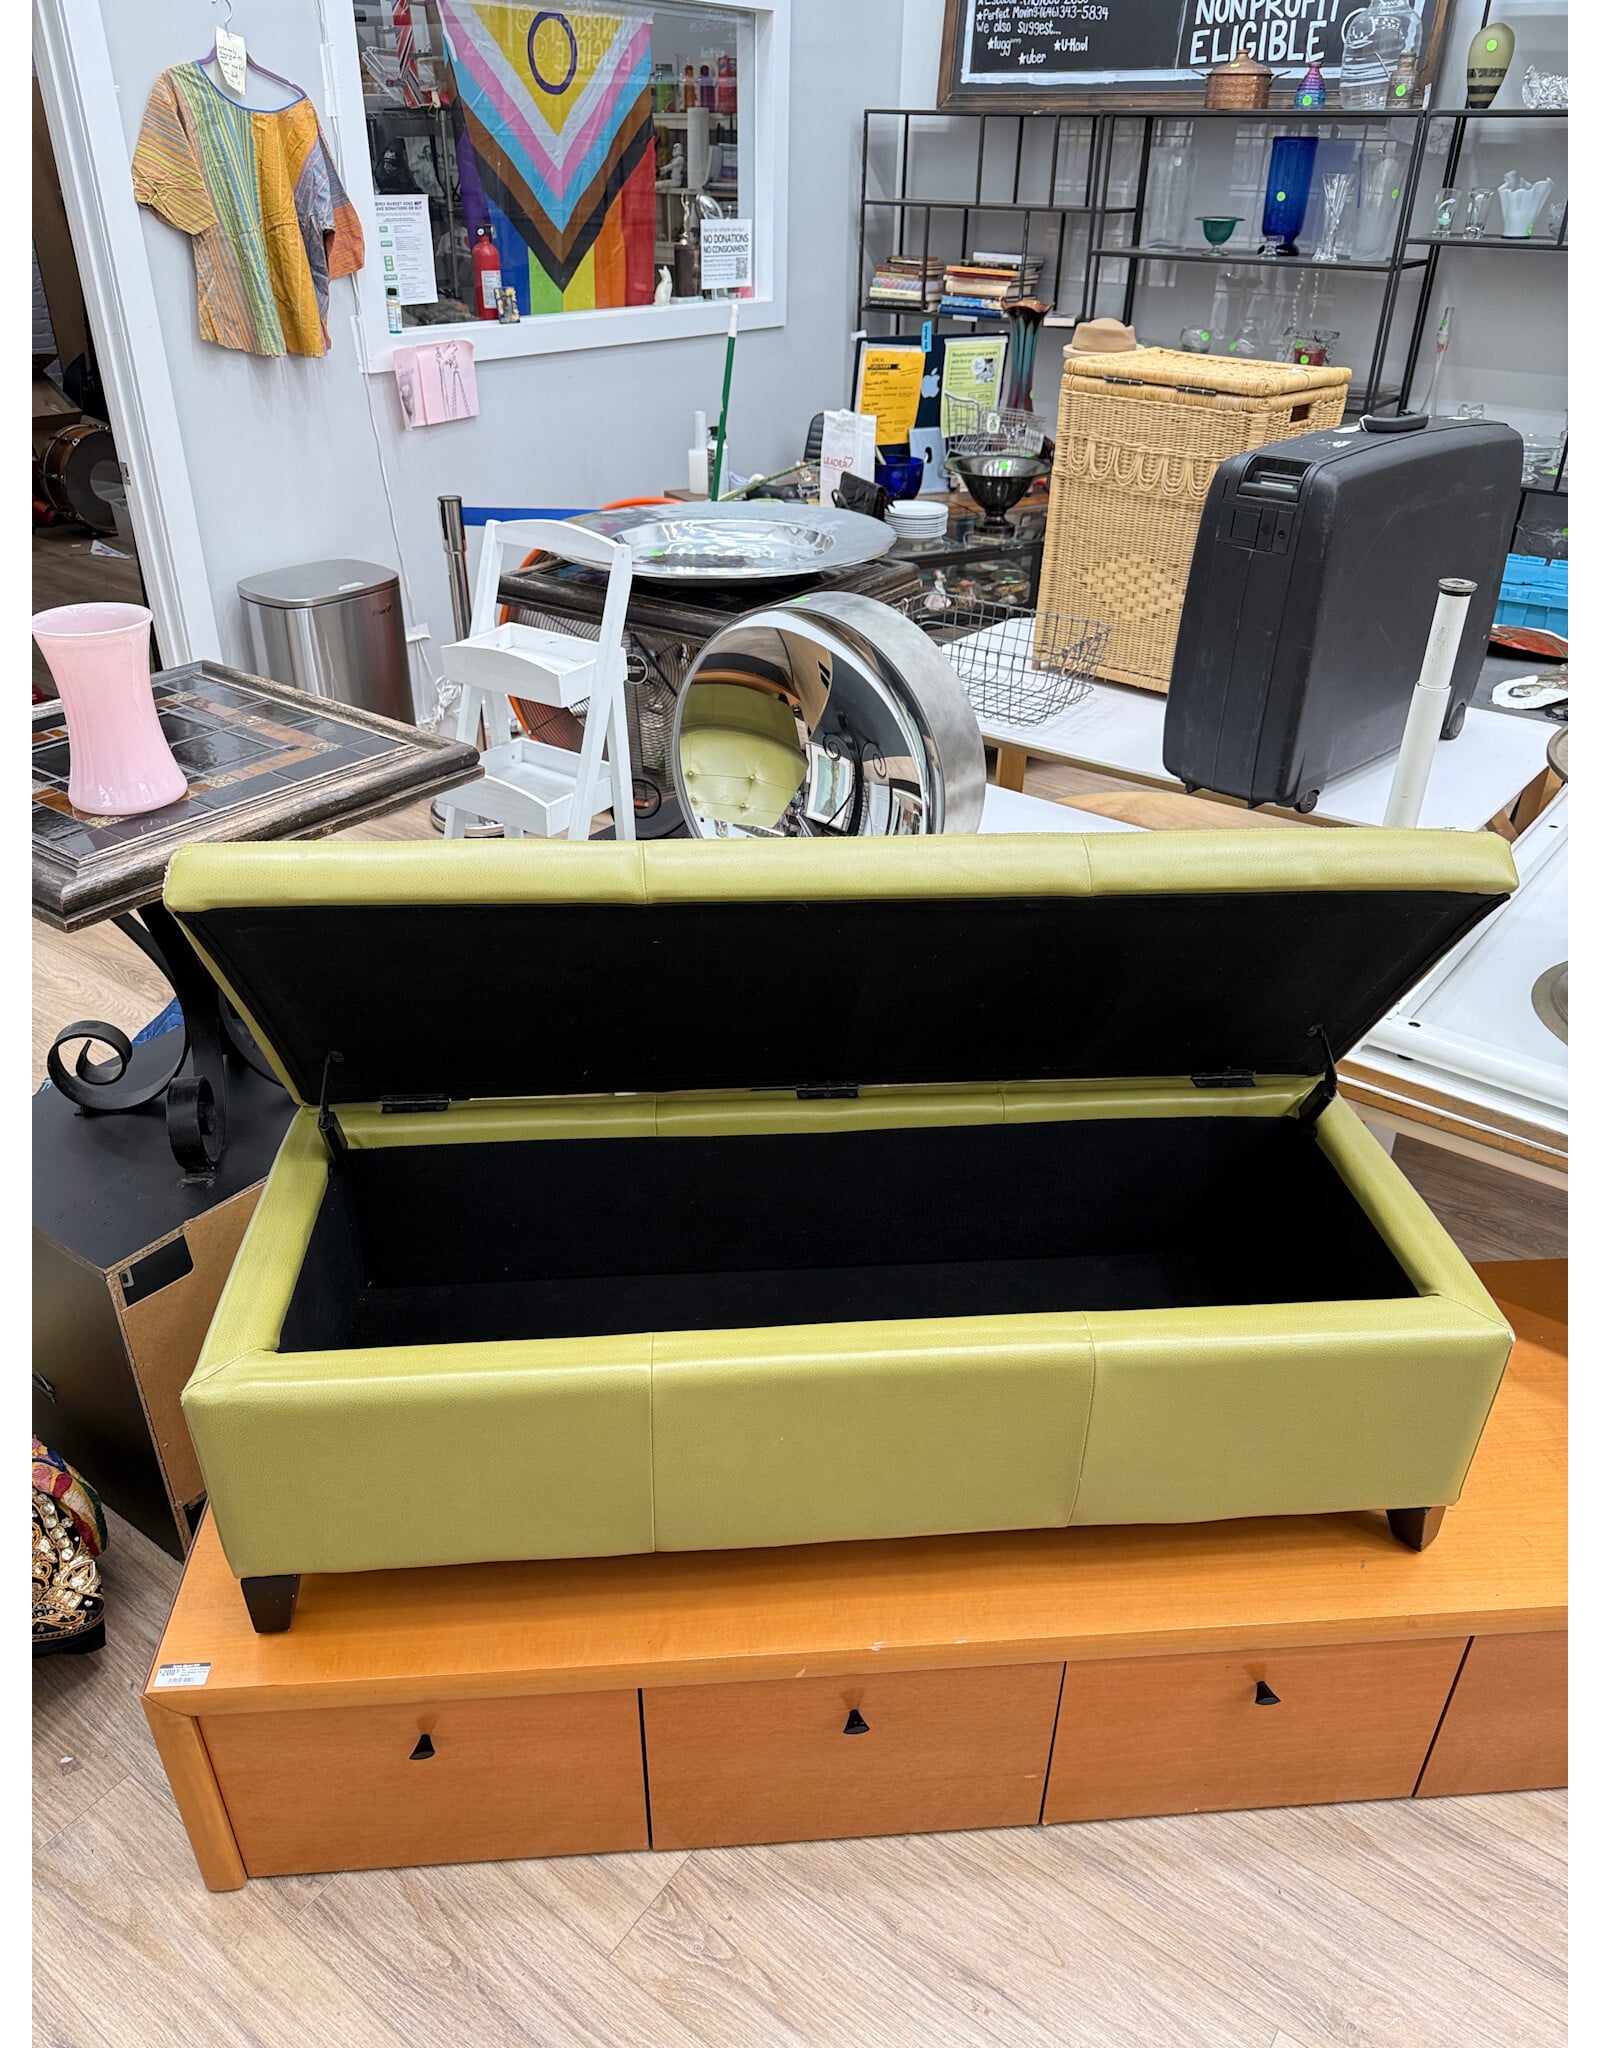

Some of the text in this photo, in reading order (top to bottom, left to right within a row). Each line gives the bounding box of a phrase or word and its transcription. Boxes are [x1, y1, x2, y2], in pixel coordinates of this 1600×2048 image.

[983, 7, 1010, 20] Perfect
[976, 21, 989, 33] We
[994, 20, 1011, 33] also
[1061, 36, 1089, 52] U-Haul
[1189, 19, 1328, 65] ELIGIBLE
[703, 233, 749, 244] NO DONATIONS
[703, 244, 749, 254] NO CONSIGNMENT
